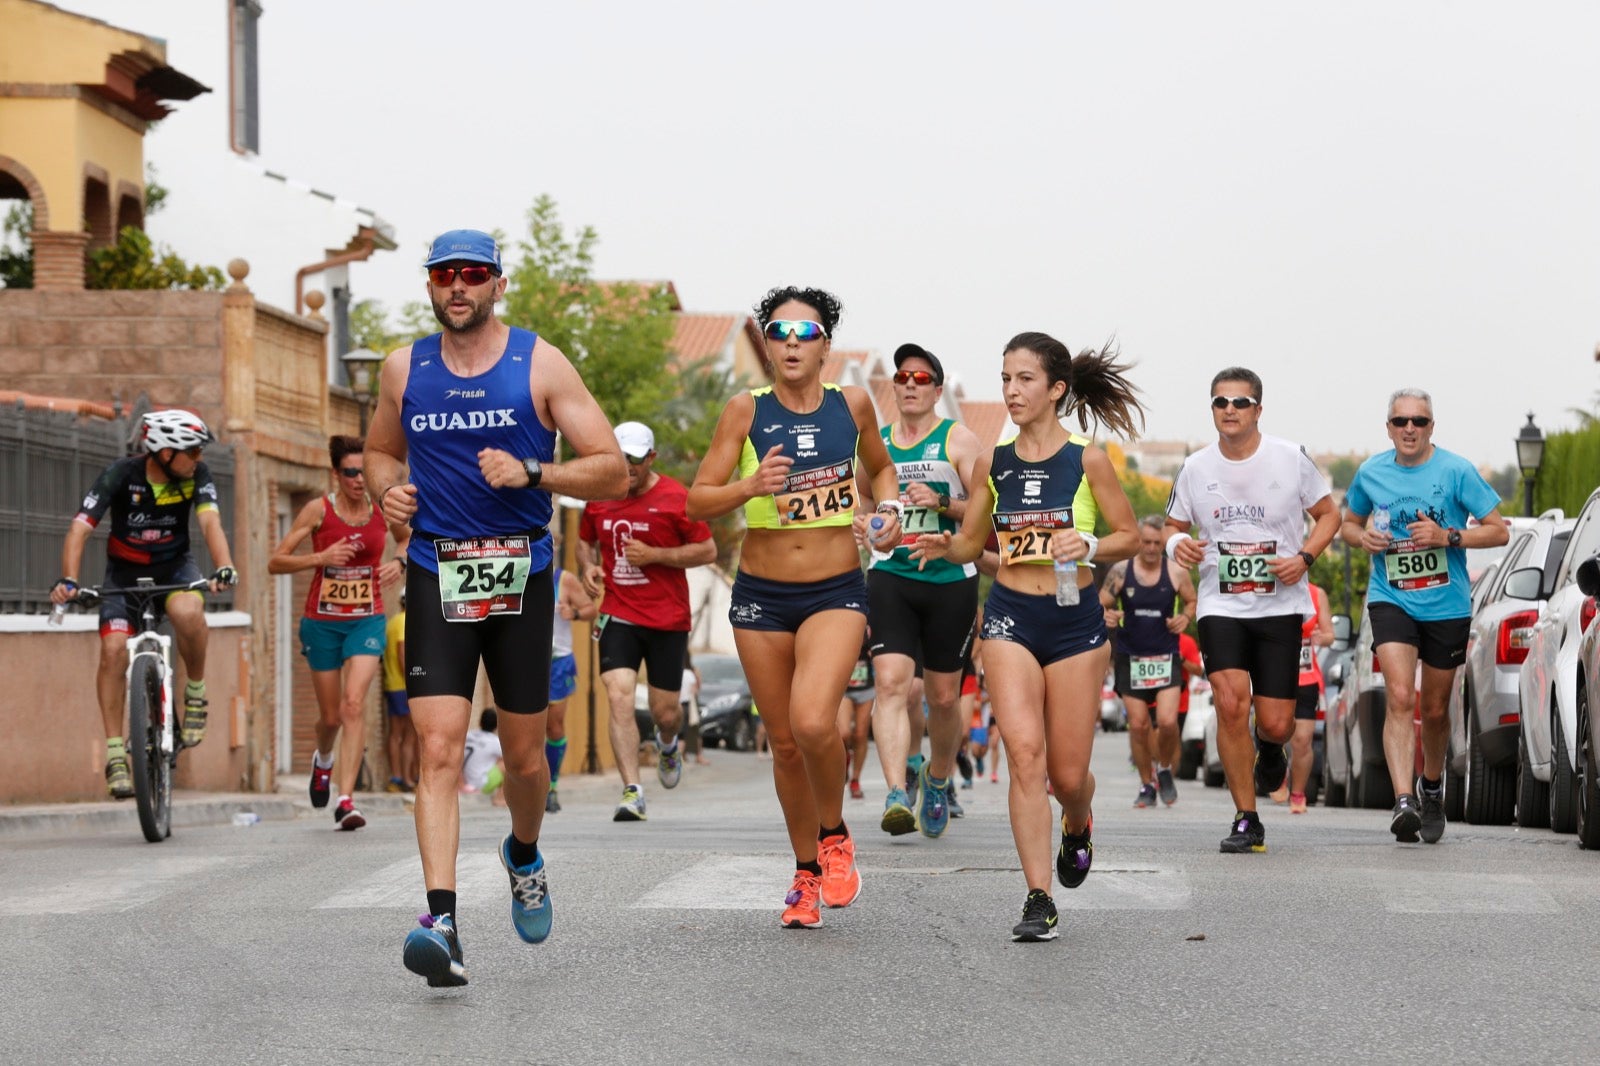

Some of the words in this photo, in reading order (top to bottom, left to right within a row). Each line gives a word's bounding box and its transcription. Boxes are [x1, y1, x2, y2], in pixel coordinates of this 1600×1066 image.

[410, 408, 518, 432] GUADIX
[790, 474, 805, 486] GRAN
[805, 469, 826, 482] PREMIO
[826, 468, 834, 477] DE
[901, 463, 934, 473] RURAL
[788, 484, 854, 521] 2145
[1220, 505, 1265, 518] TEXCON
[904, 508, 928, 529] 77
[1009, 514, 1023, 525] GRAN
[1022, 513, 1042, 524] PREMIO
[1043, 512, 1050, 522] DE
[1009, 531, 1052, 560] 227
[1227, 557, 1268, 578] 692
[1397, 552, 1438, 575] 580
[456, 561, 515, 595] 254
[328, 582, 369, 600] 2012
[1138, 663, 1165, 677] 805
